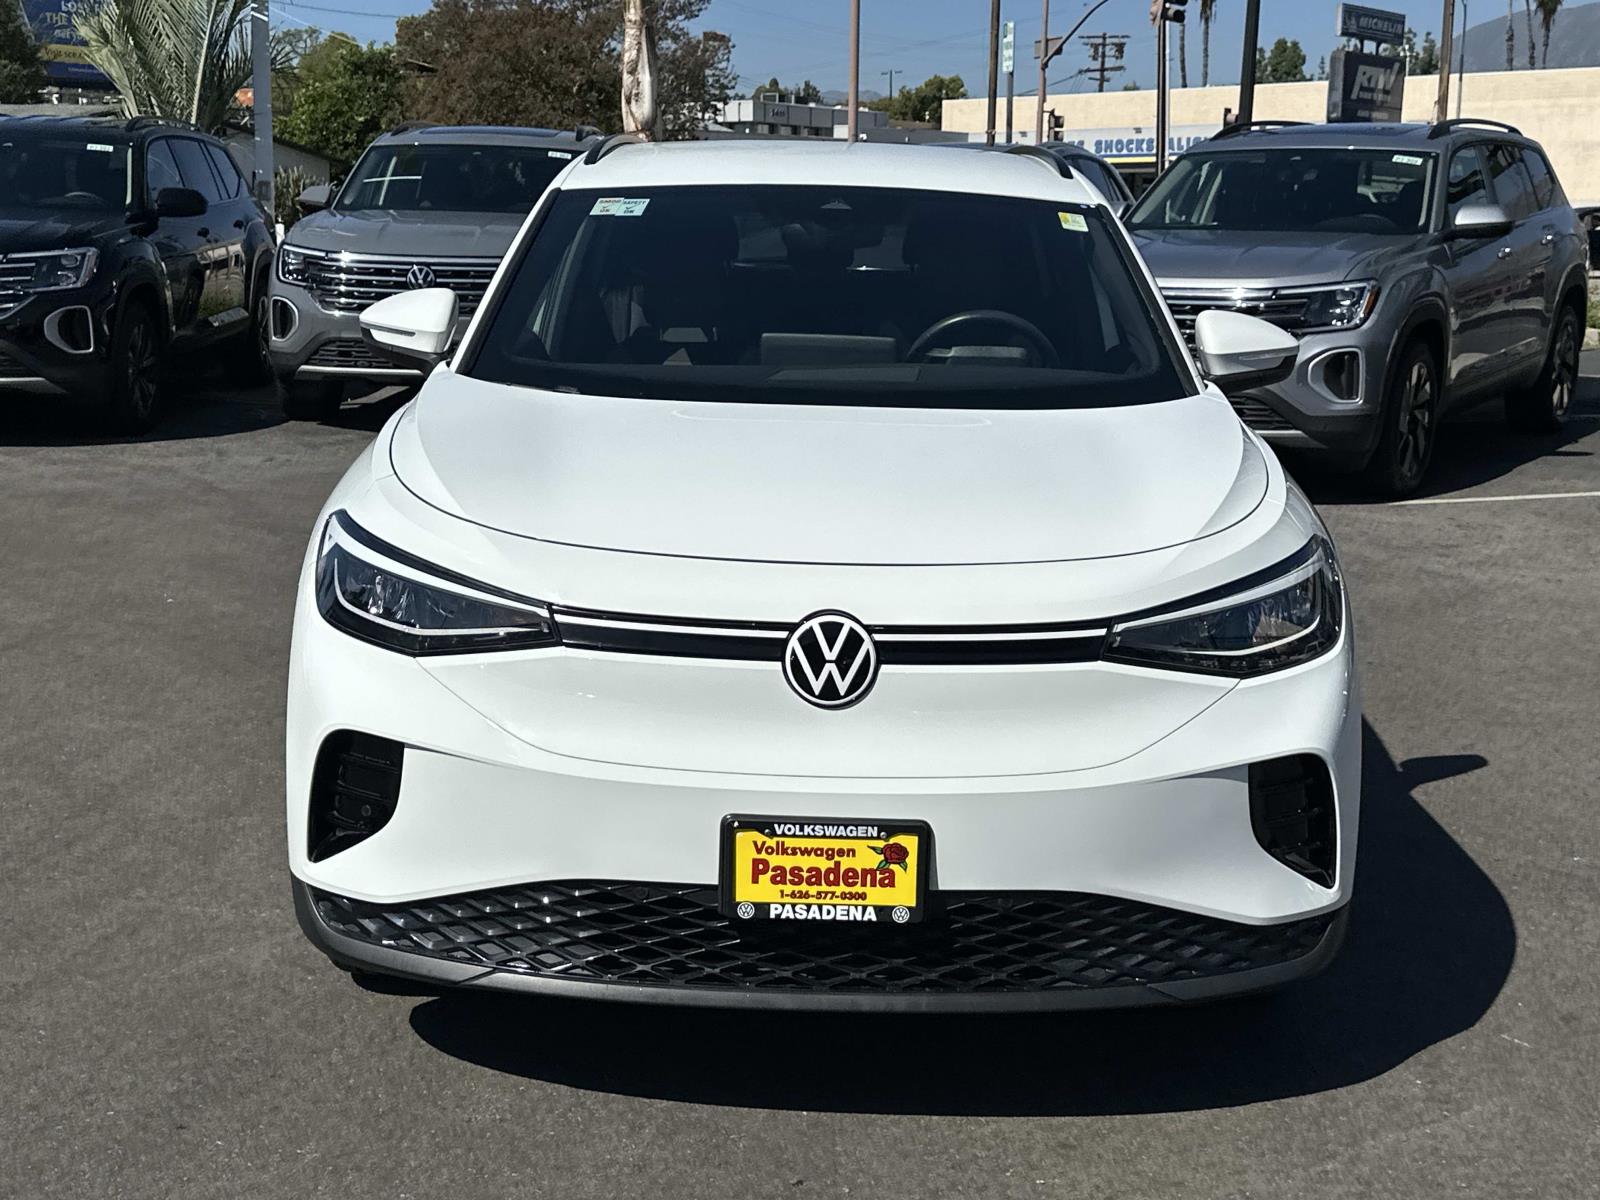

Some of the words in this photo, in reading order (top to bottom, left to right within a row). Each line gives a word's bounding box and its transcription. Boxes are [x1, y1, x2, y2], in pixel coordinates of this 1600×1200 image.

[1359, 15, 1403, 34] MICHELIN
[1094, 137, 1155, 153] SHOCKS
[785, 614, 876, 705] VW
[773, 823, 878, 838] VOLKSWAGEN
[752, 840, 856, 861] Volkswagen
[751, 858, 896, 888] Pasadena
[779, 889, 867, 901] 1-626-577-0300
[769, 903, 877, 922] PASADENA
